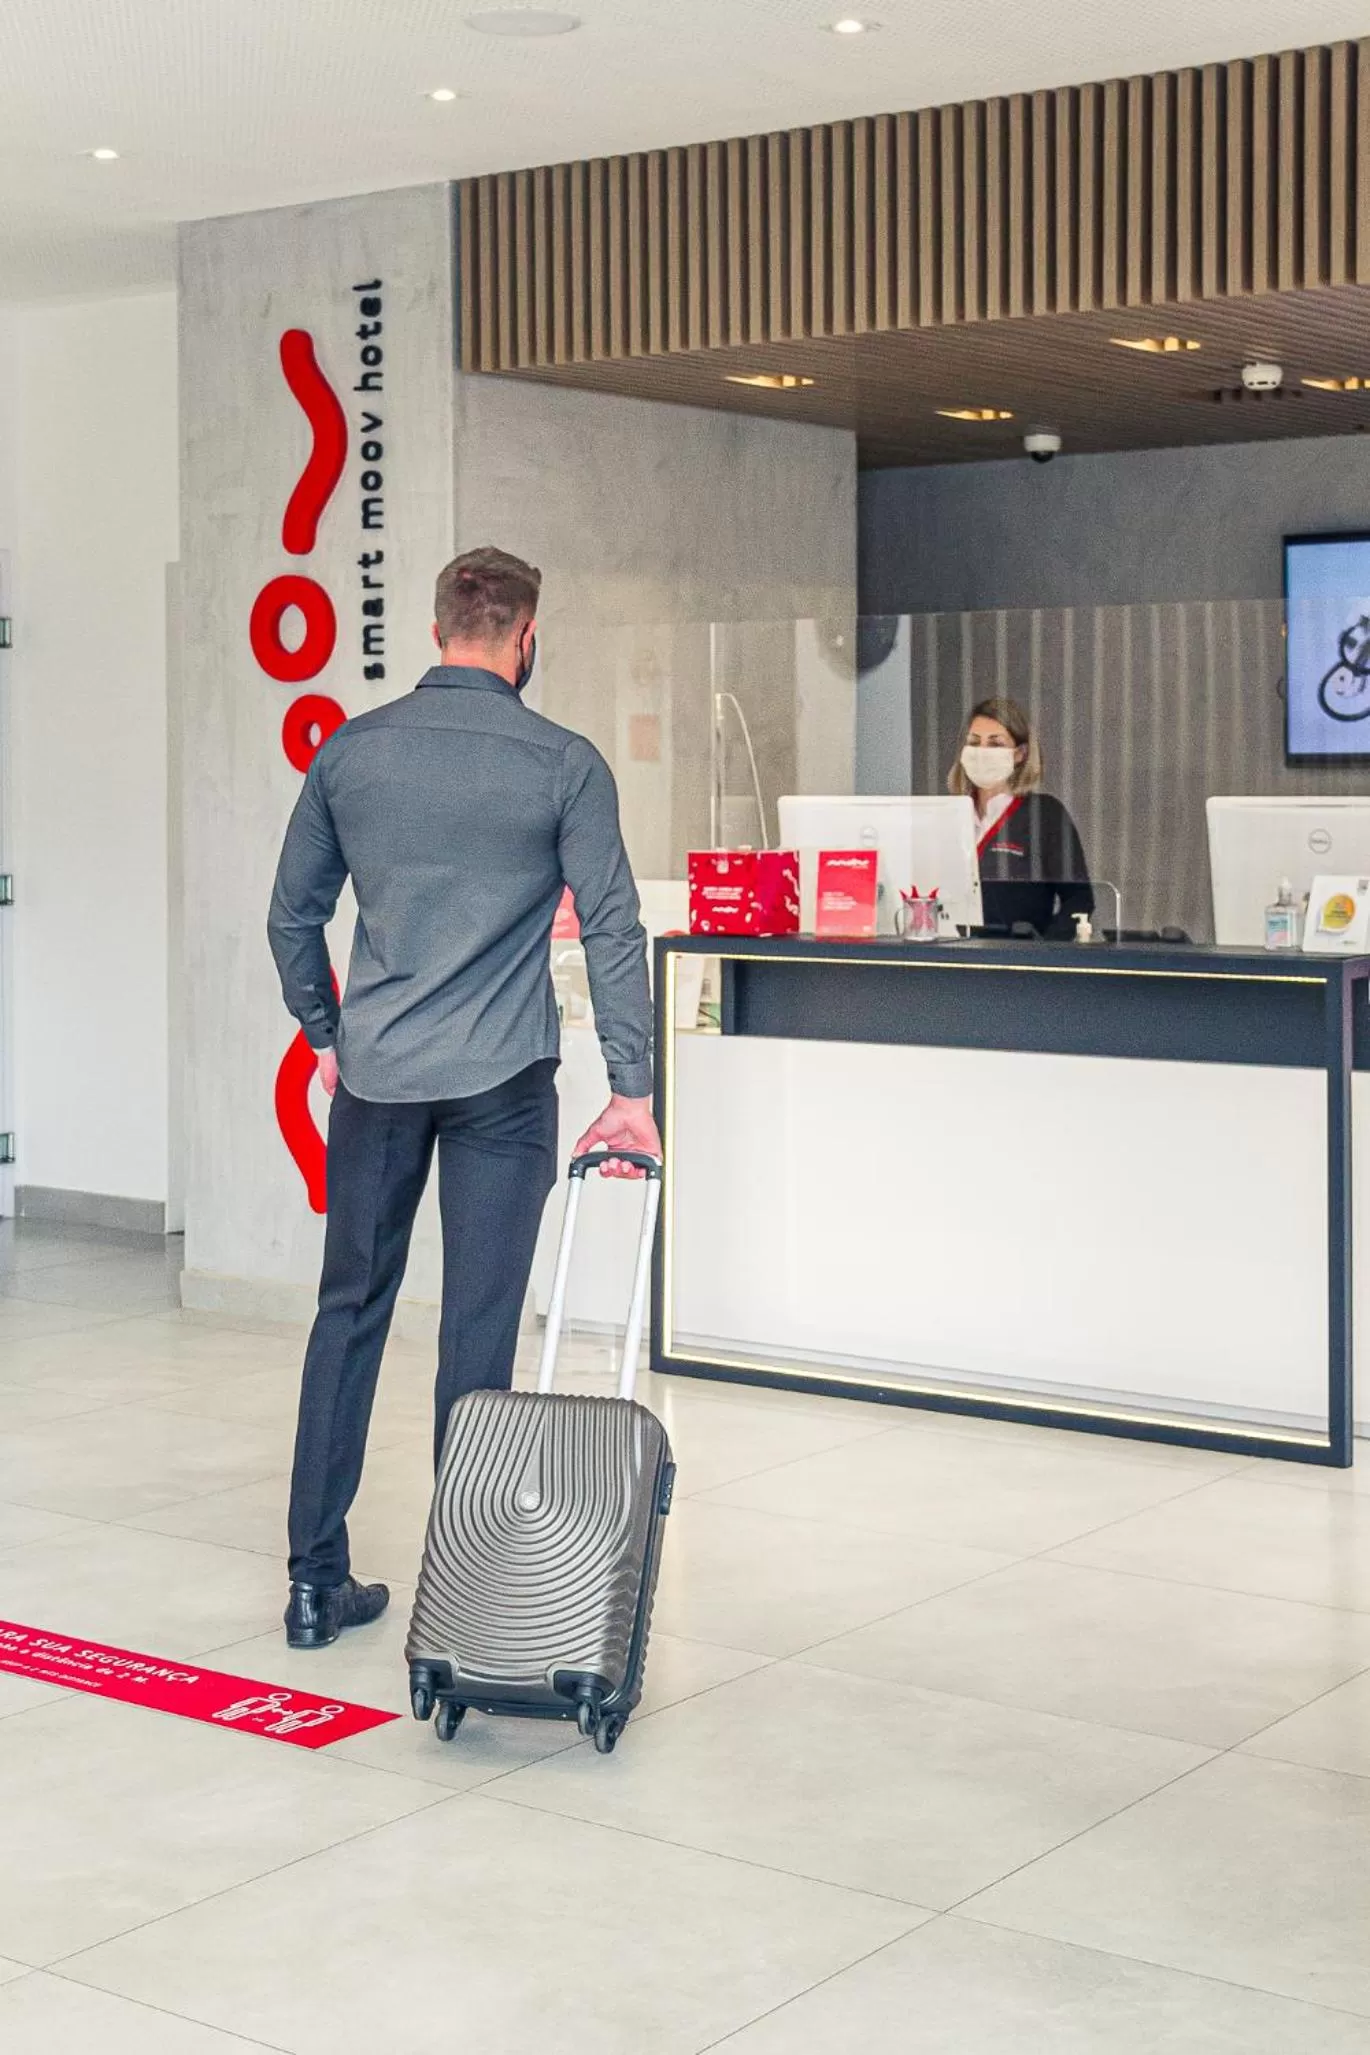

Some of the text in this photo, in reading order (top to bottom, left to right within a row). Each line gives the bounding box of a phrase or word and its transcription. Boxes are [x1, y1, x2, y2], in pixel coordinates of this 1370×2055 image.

[353, 278, 385, 681] smart moov hotel
[29, 1638, 72, 1653] SUA
[74, 1649, 199, 1684] SEGURANÇA
